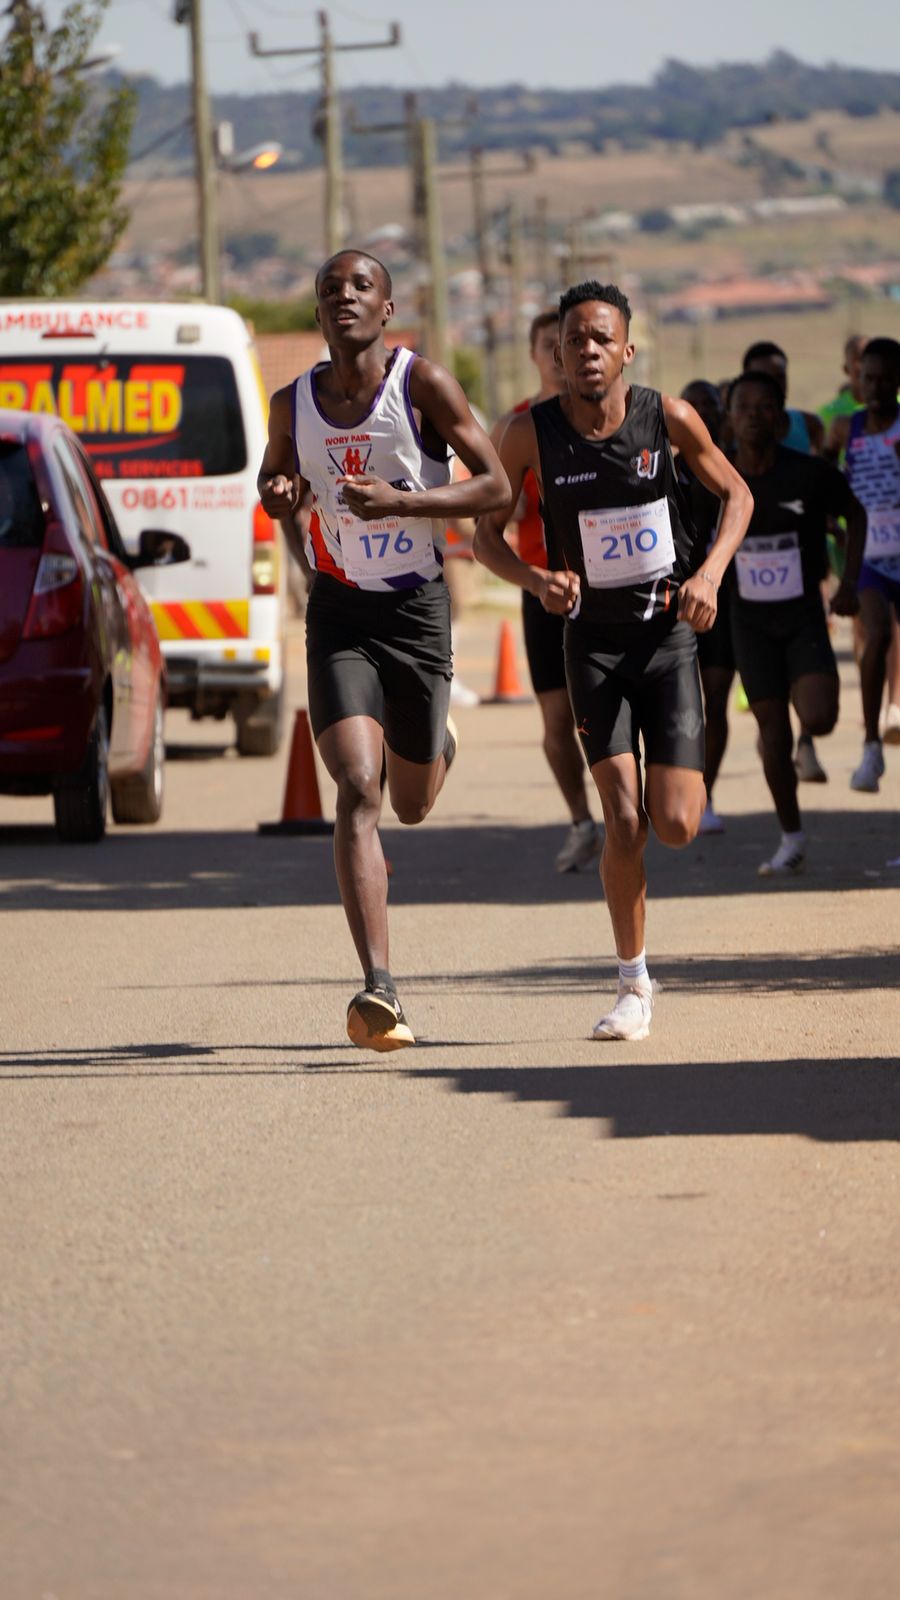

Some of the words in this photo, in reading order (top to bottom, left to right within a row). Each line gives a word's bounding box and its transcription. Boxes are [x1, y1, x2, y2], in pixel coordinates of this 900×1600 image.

[0, 311, 148, 333] MBULANCE
[325, 436, 349, 446] IVORY
[351, 434, 371, 442] PARK
[567, 472, 597, 484] lotto
[121, 486, 189, 510] 0861
[366, 522, 386, 531] STREET
[359, 530, 414, 560] 176
[601, 528, 658, 560] 210
[749, 566, 789, 587] 107
